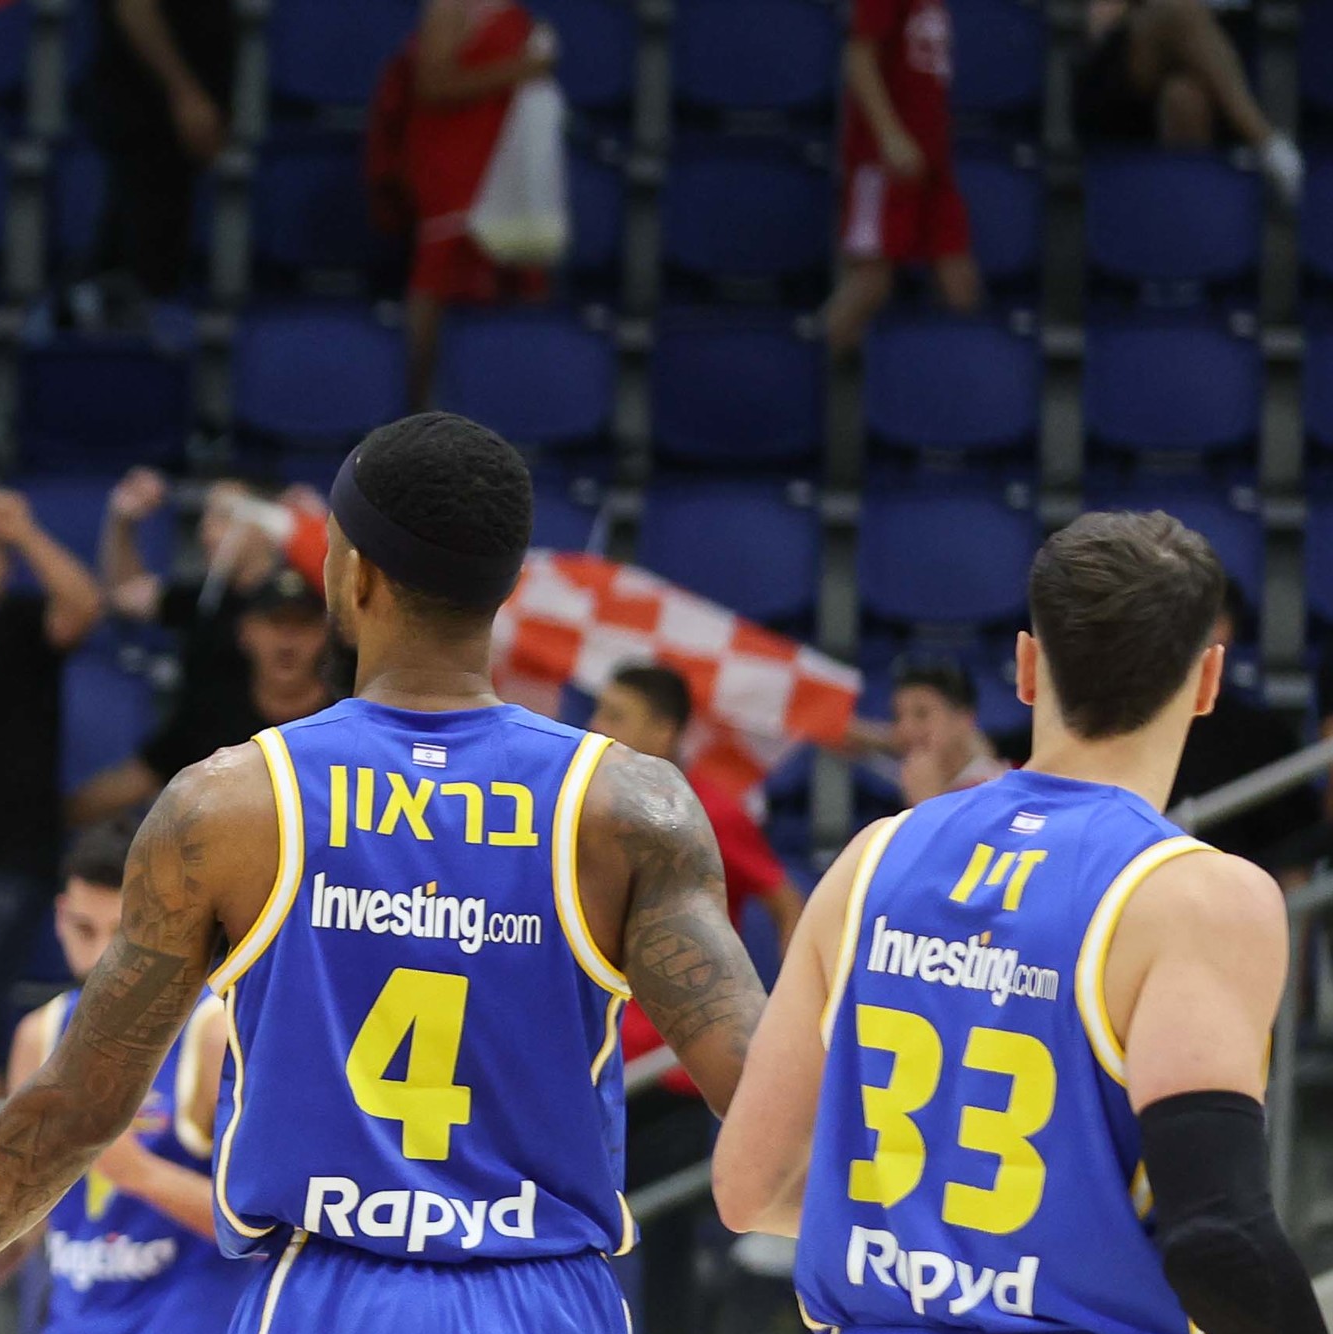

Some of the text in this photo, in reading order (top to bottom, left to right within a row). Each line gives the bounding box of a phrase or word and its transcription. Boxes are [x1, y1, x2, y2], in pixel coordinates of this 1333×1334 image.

[329, 765, 539, 848] בראון
[311, 871, 542, 954] Investing.com
[345, 967, 471, 1161] 4
[847, 1003, 1057, 1235] 33
[303, 1175, 536, 1253] Rapyd
